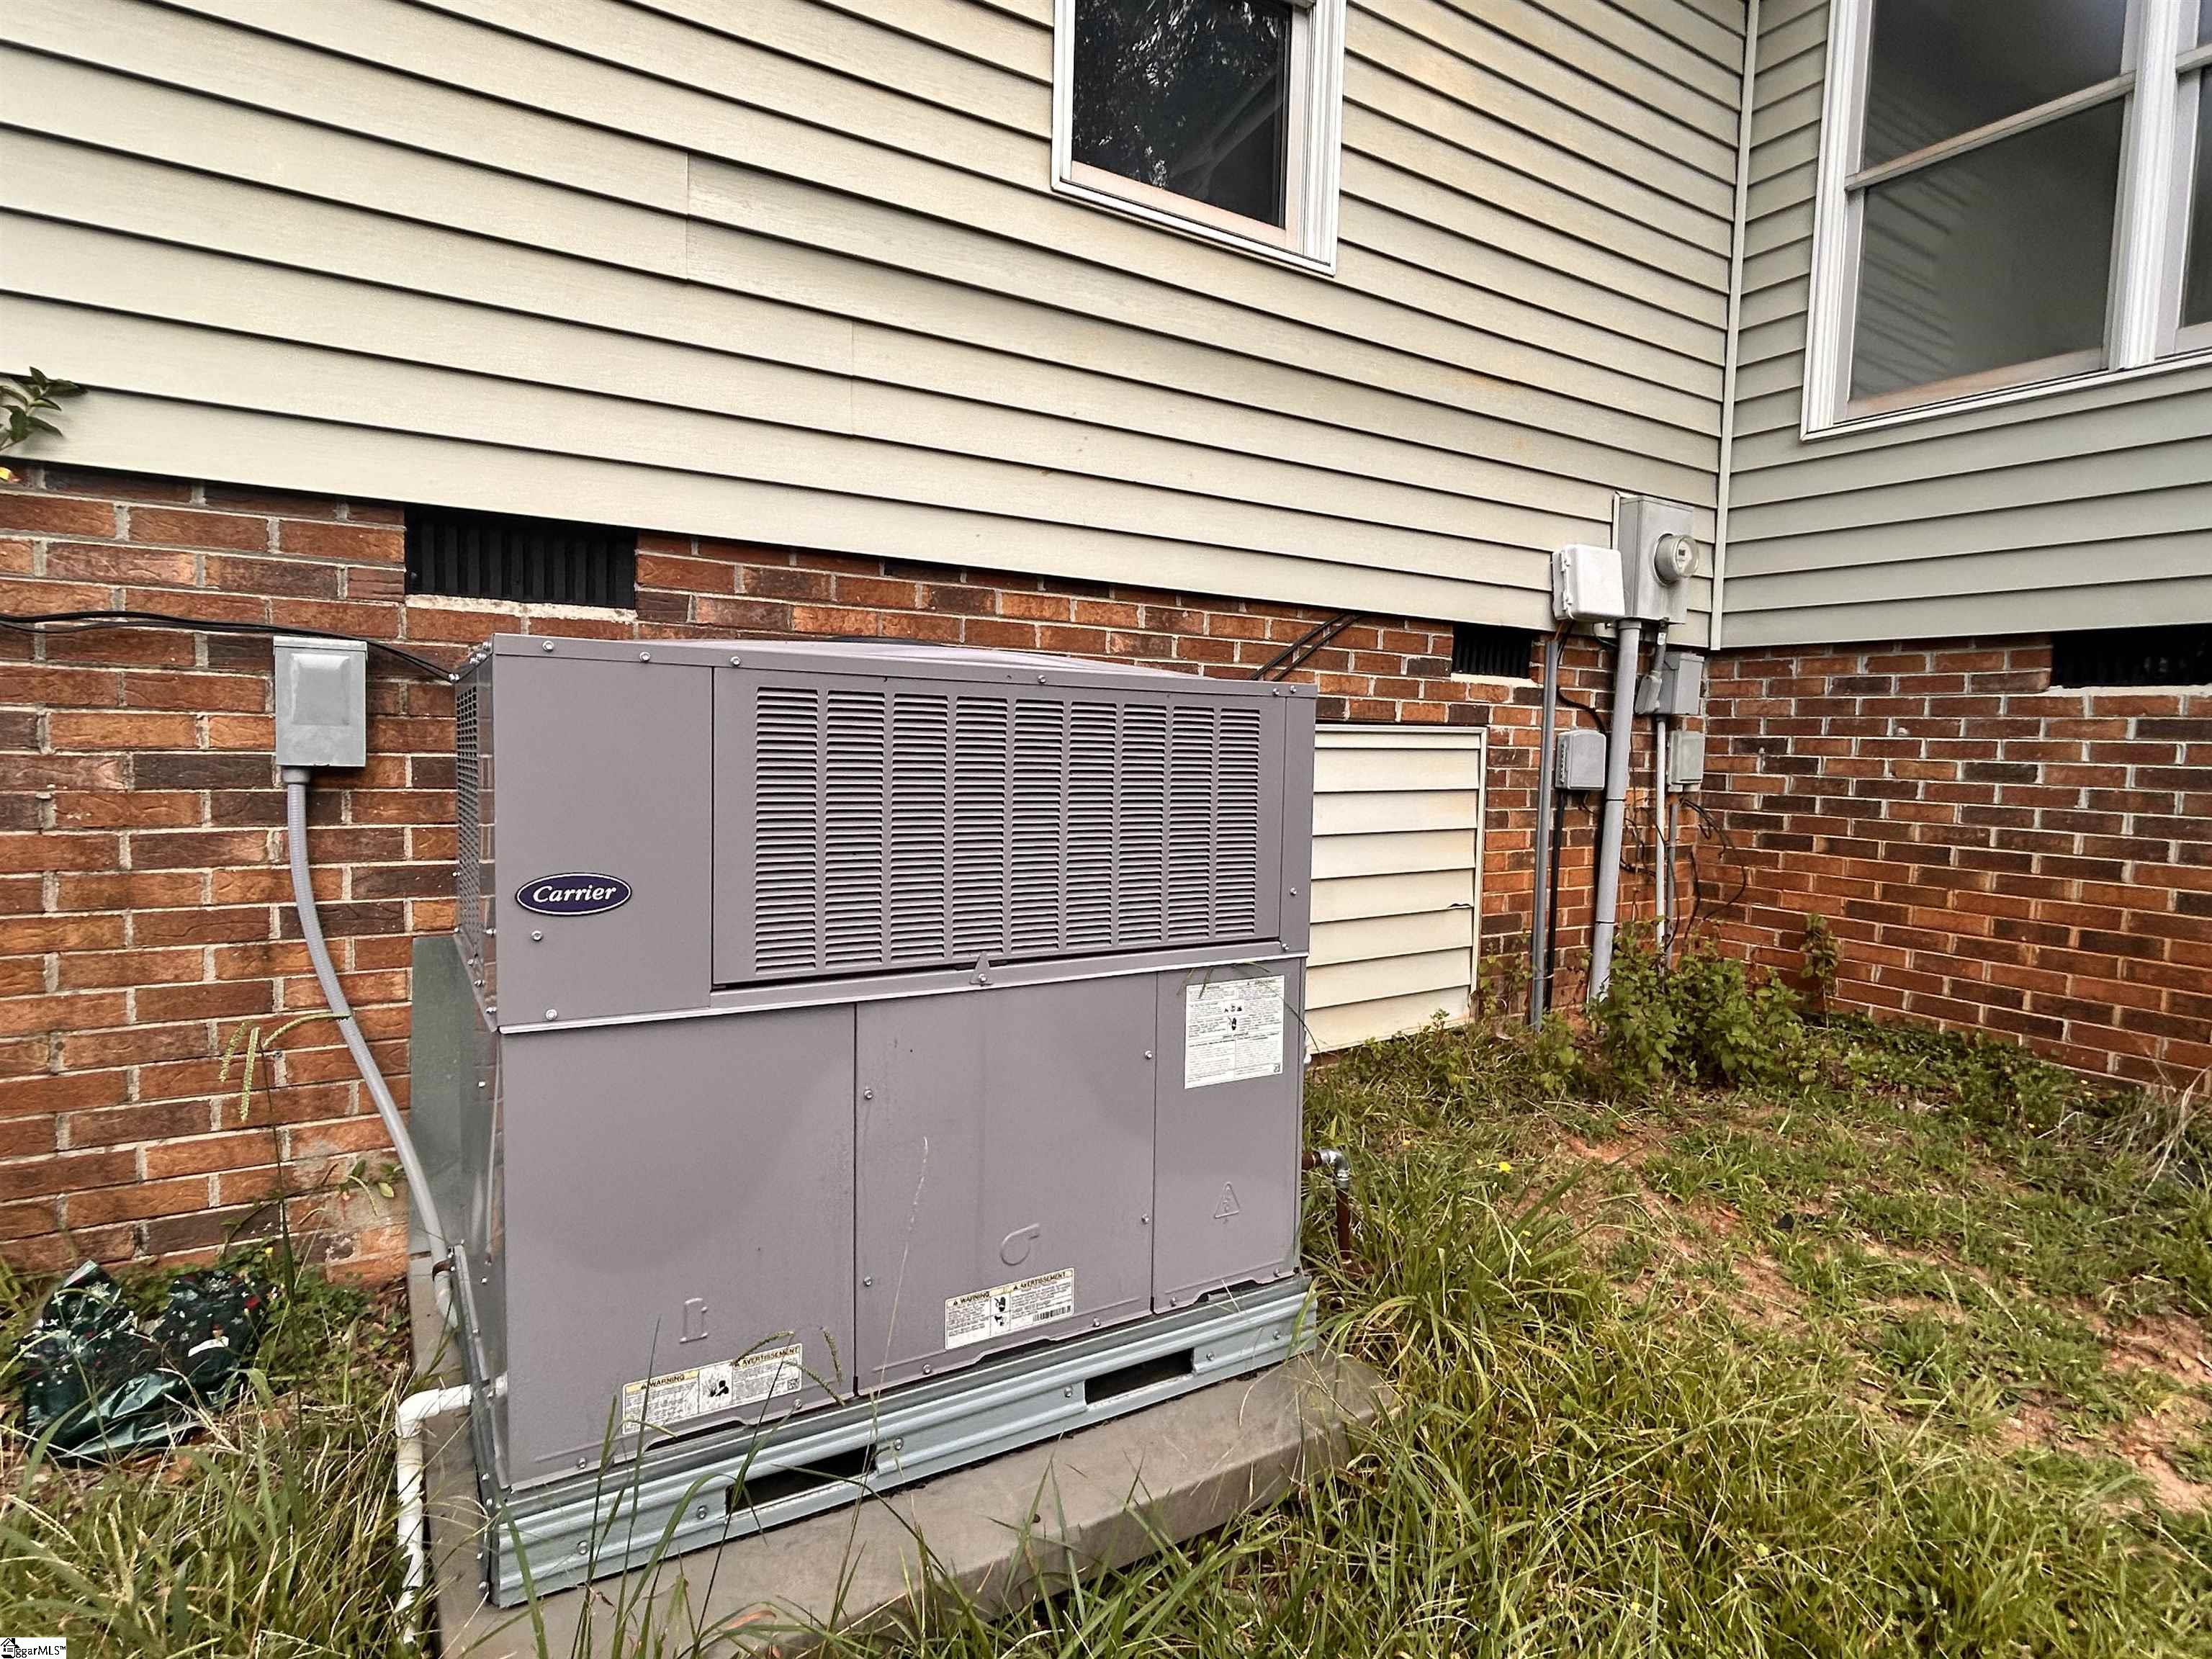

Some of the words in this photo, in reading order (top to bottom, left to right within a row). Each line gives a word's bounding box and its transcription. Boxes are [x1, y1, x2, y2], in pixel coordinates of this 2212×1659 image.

[533, 885, 616, 903] Carrier
[1020, 1272, 1066, 1288] AVERTISSEMENT
[961, 1291, 989, 1303] WARNING
[743, 1348, 799, 1365] AVERTISSEMENT
[650, 1374, 684, 1388] WARNING
